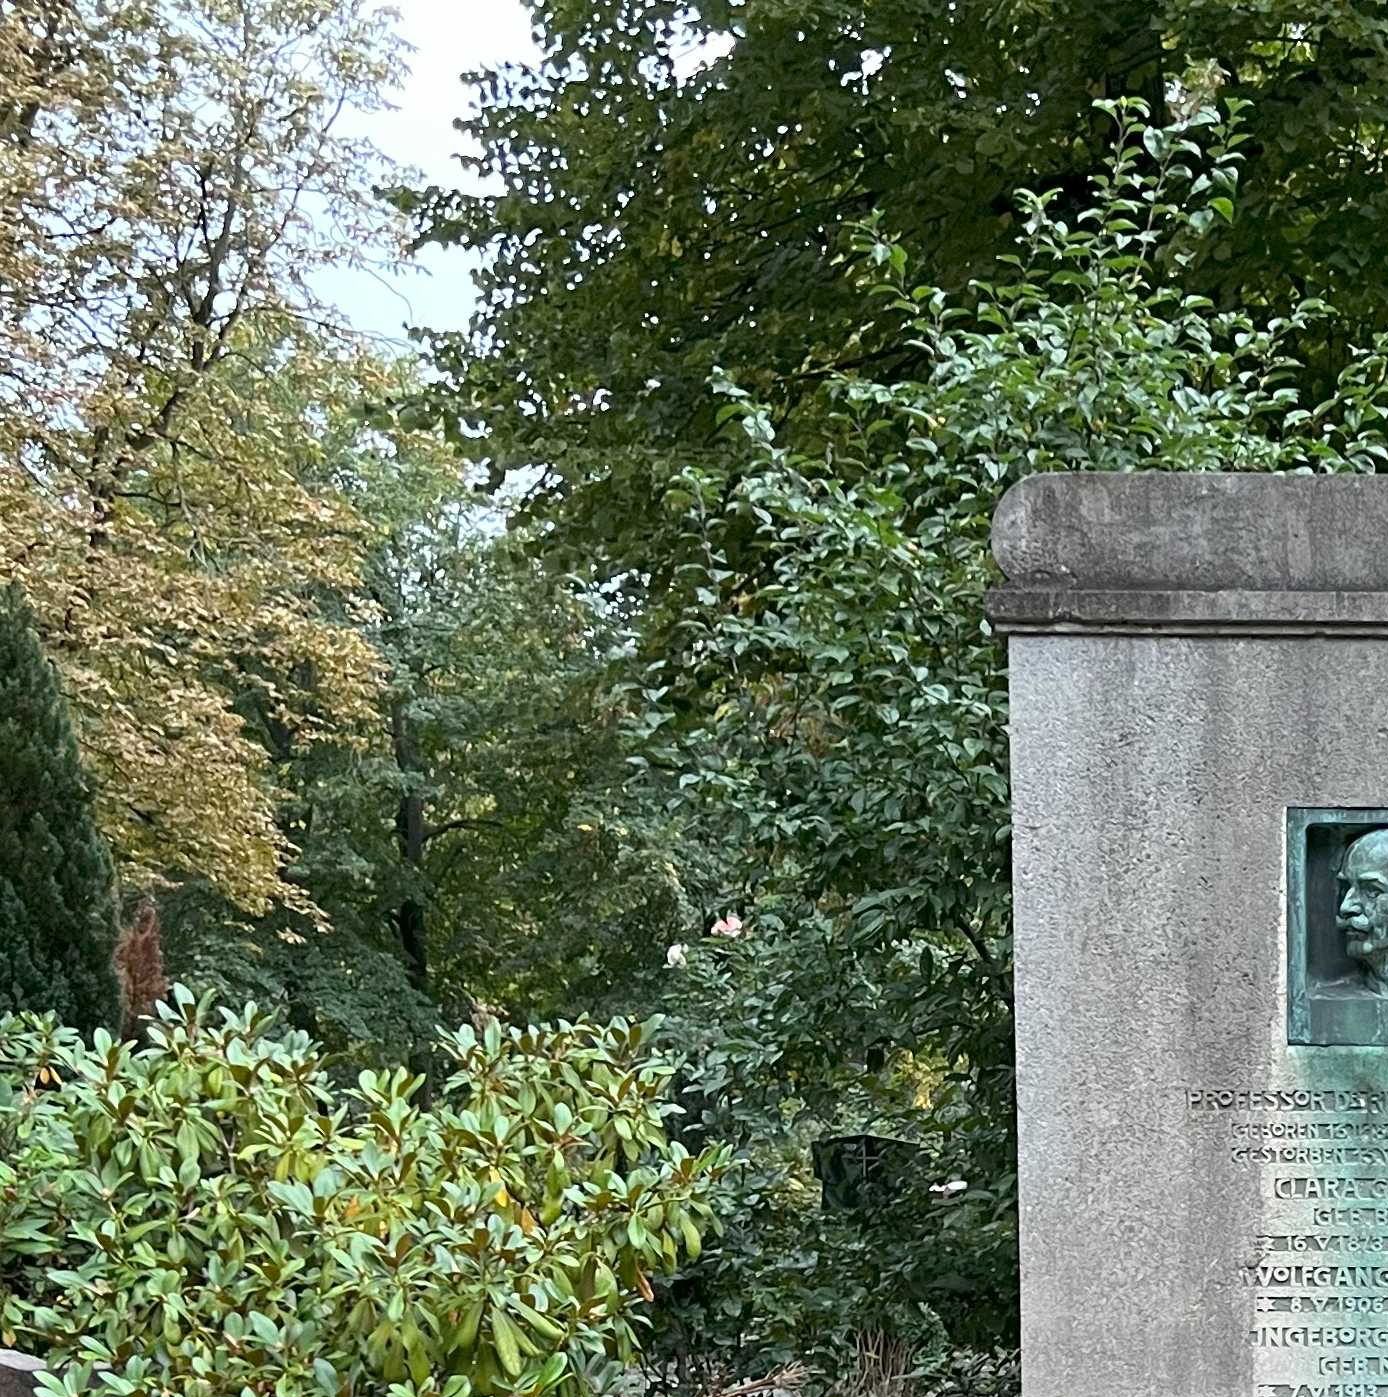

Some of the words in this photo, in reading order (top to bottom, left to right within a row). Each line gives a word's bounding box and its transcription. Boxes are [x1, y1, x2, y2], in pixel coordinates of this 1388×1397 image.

[1188, 1090, 1326, 1112] PROFESSOR
[1232, 1122, 1319, 1140] GEBOREN
[1232, 1147, 1345, 1164] GESTORBEN
[1275, 1178, 1360, 1199] CLARA
